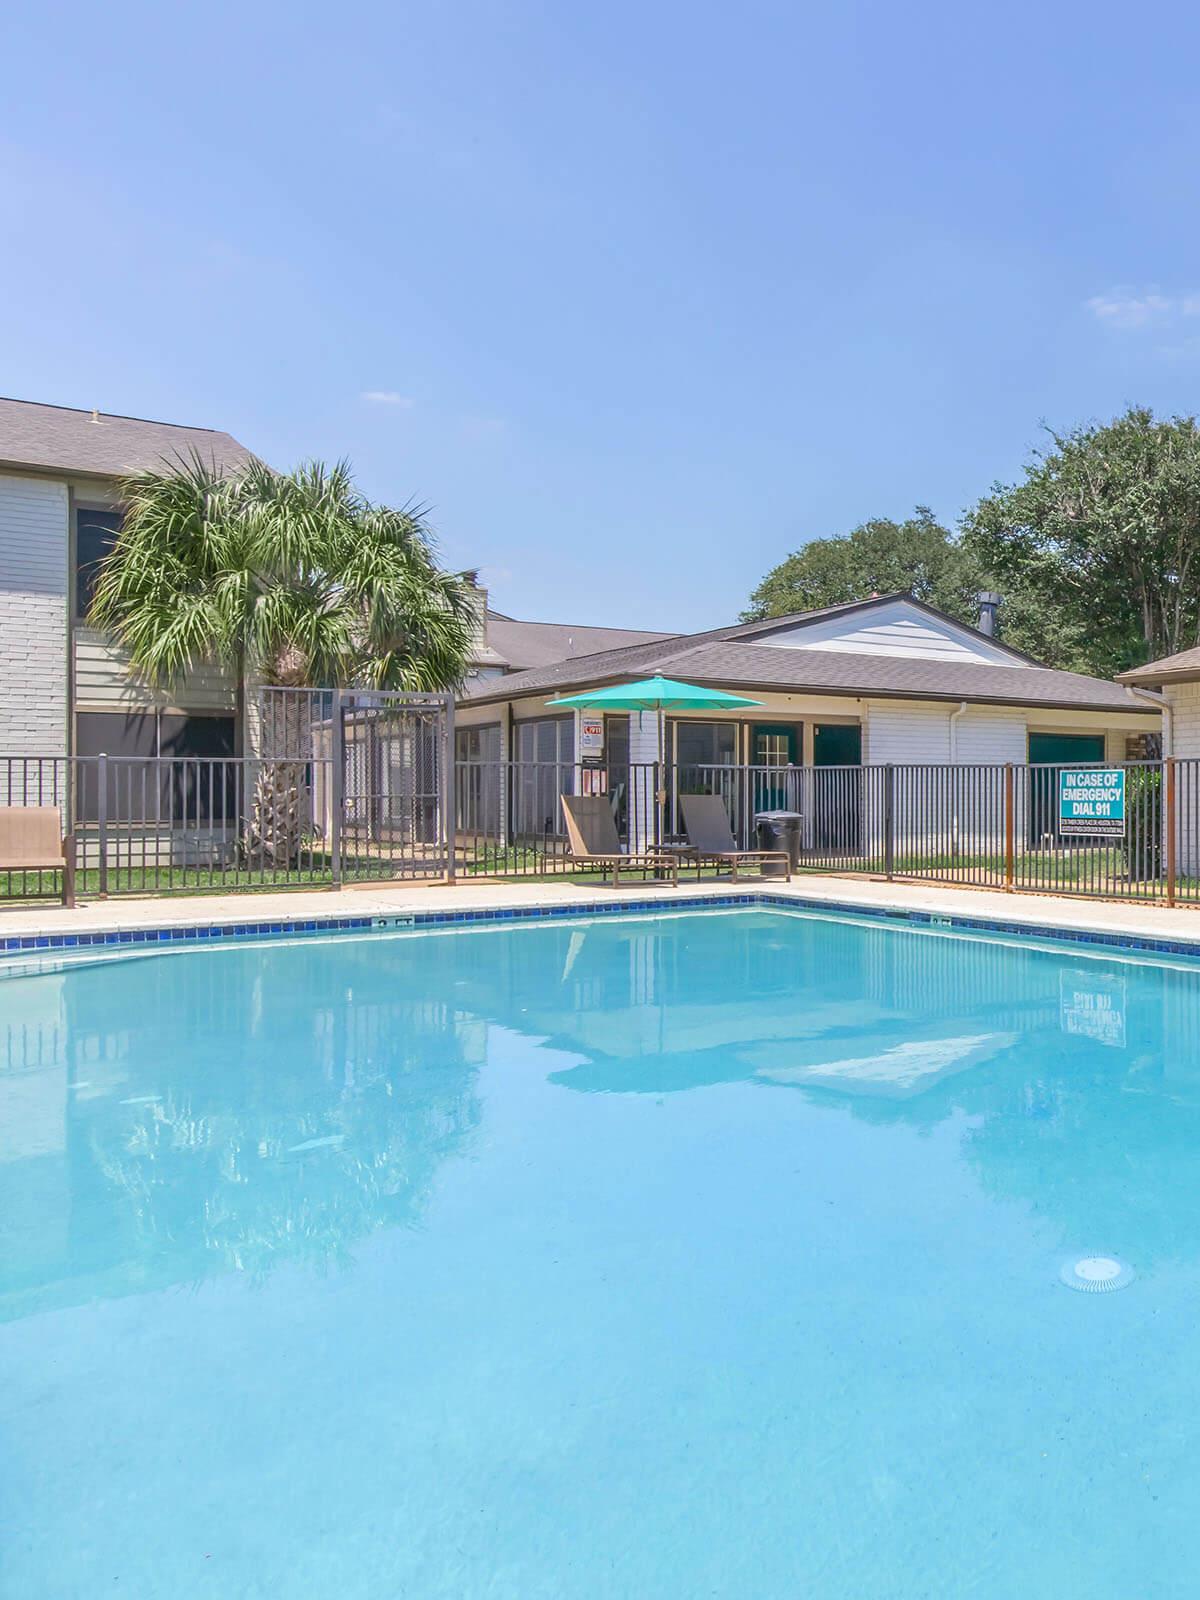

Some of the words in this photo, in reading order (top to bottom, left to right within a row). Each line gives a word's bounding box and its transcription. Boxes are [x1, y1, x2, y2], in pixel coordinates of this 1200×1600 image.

[1066, 774, 1076, 786] IN
[1077, 774, 1103, 787] CASE
[1104, 773, 1118, 786] OF
[1063, 788, 1121, 801] EMERGENCY
[1072, 802, 1095, 815] DIAL
[1096, 803, 1110, 816] 911
